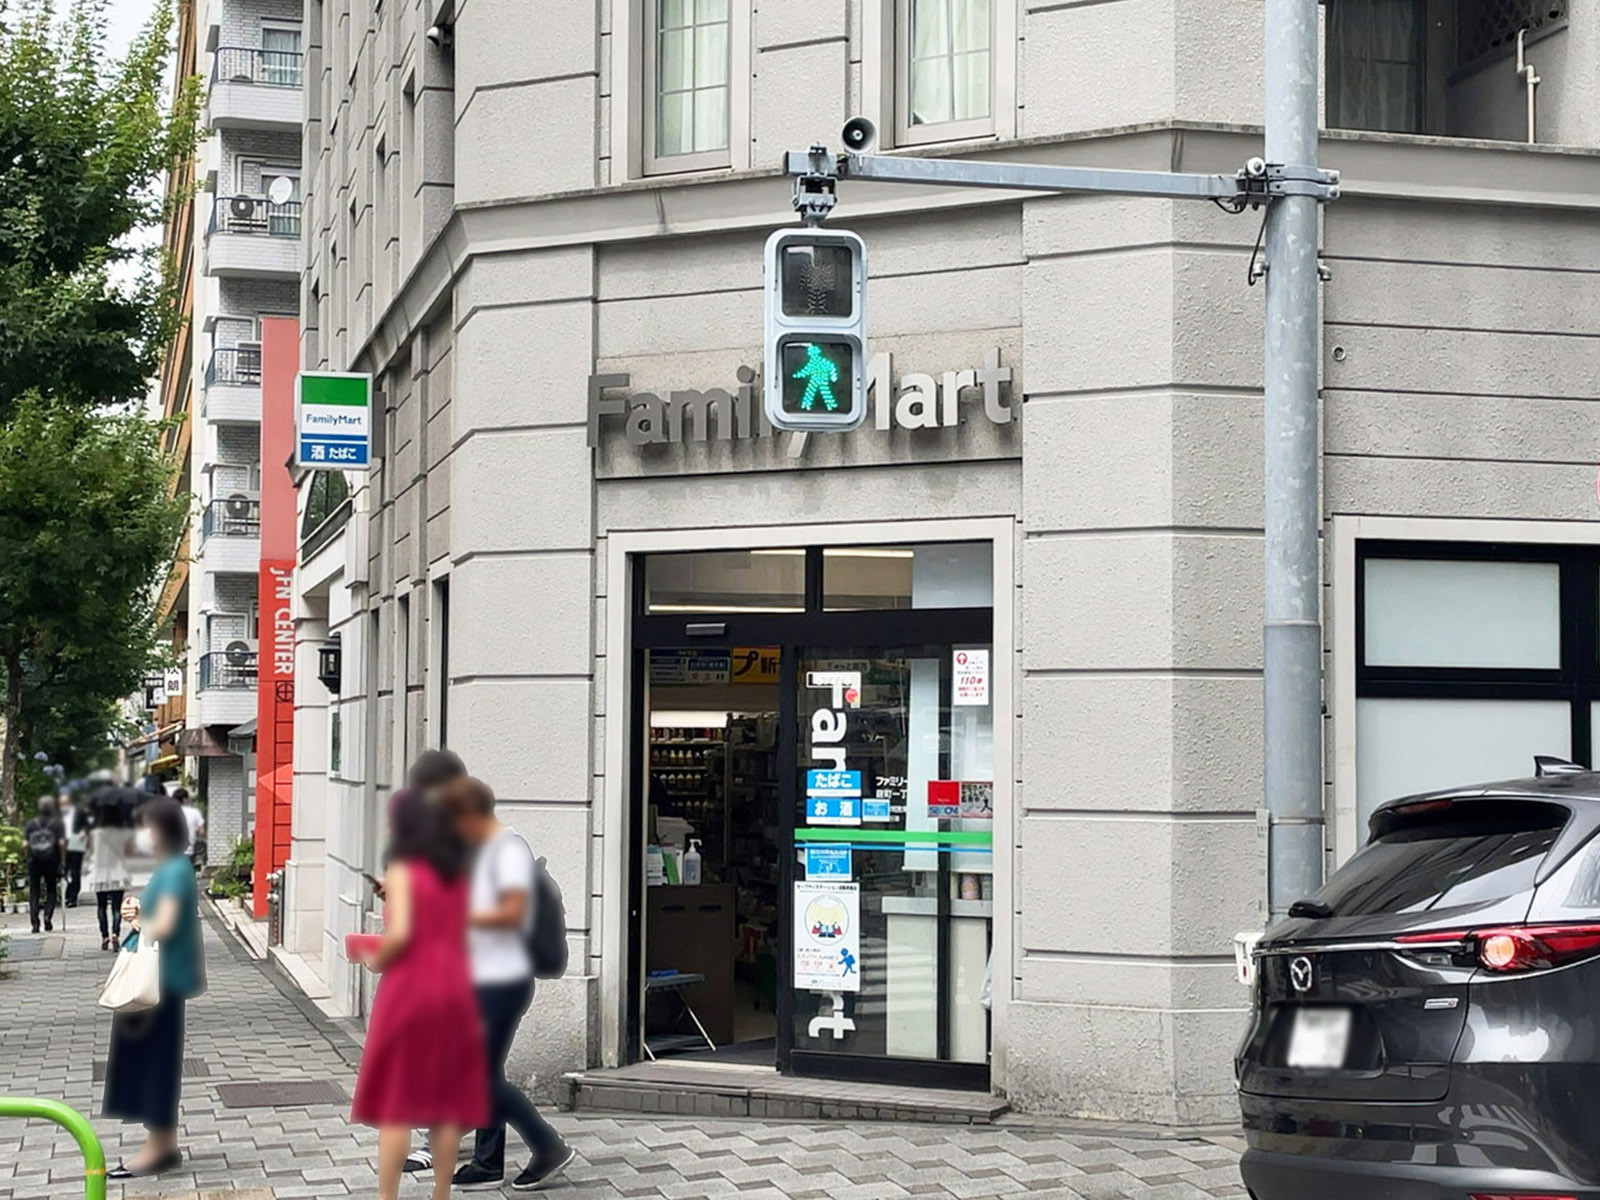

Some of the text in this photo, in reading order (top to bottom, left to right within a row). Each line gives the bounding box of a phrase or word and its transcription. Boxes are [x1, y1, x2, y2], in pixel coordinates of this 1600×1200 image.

[306, 413, 361, 425] FamilyMart
[311, 444, 357, 460] 酒 たばこ
[274, 607, 295, 674] CENTER
[814, 773, 853, 788] たばこ
